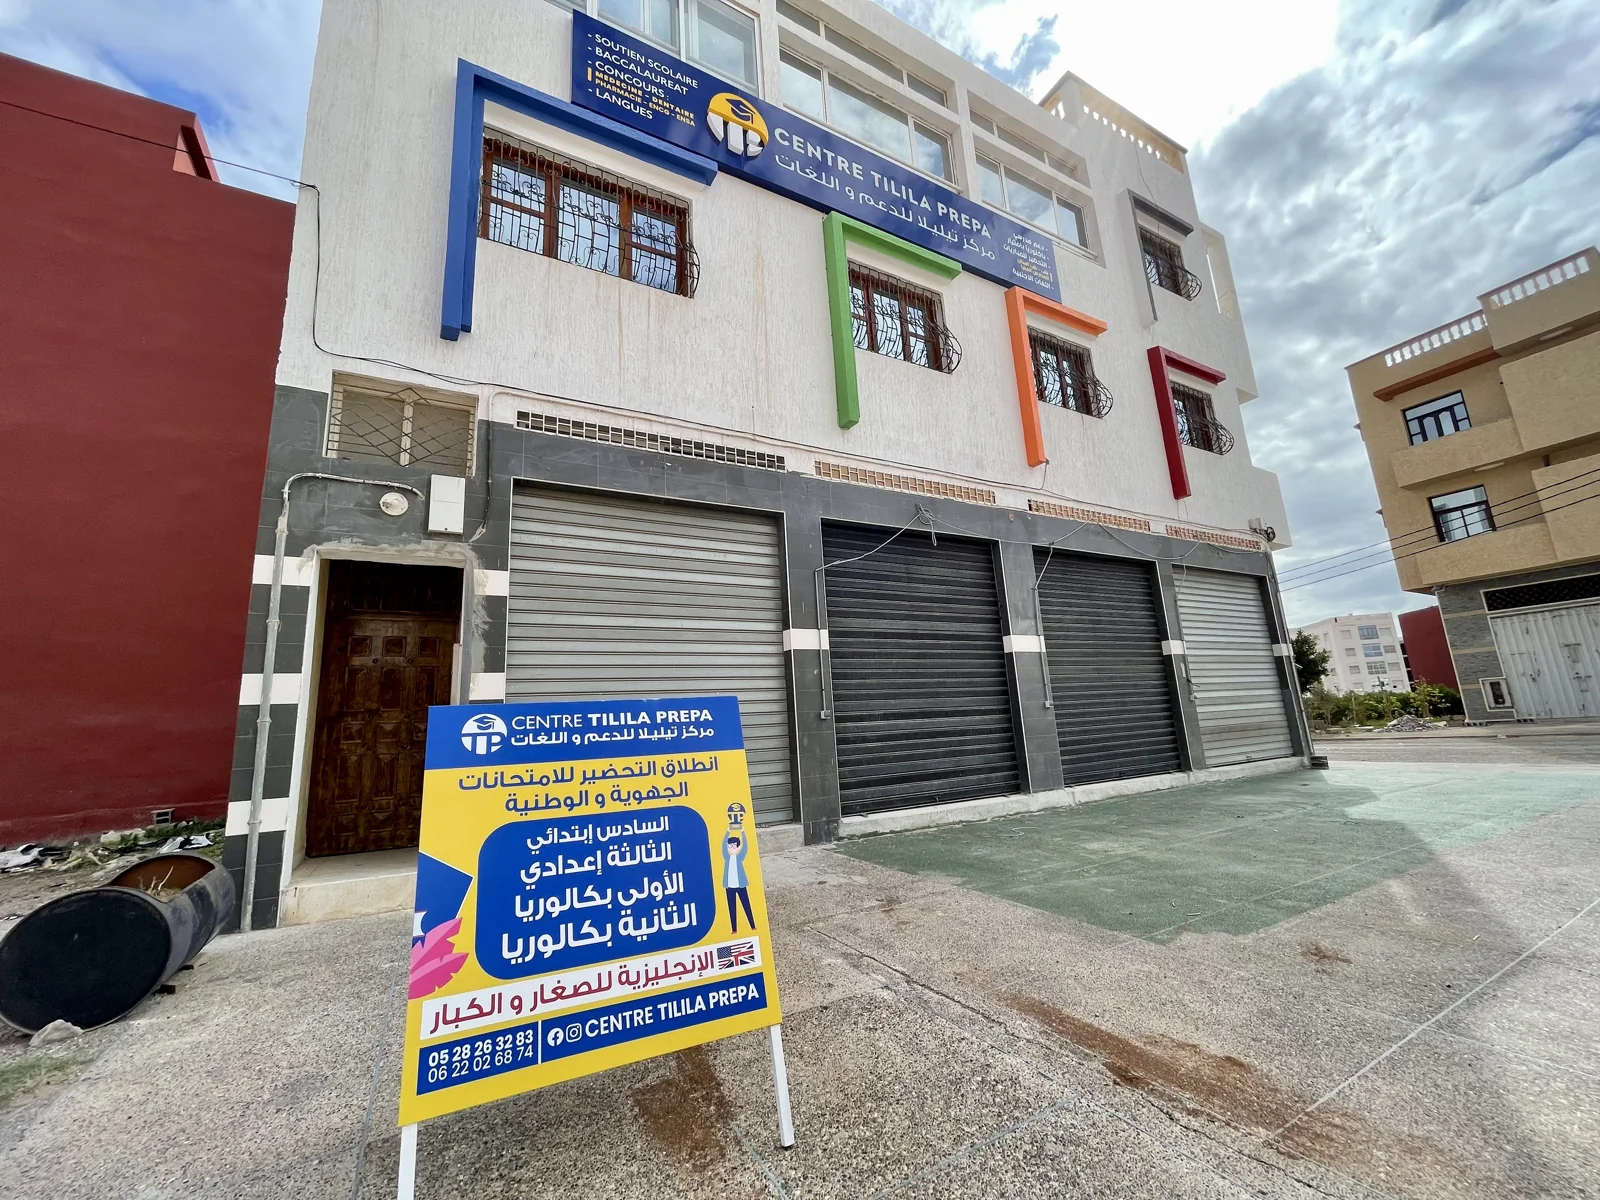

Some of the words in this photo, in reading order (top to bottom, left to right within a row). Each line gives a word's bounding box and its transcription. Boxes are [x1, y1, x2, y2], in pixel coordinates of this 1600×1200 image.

[595, 34, 645, 64] SOUTIEN
[647, 59, 699, 89] SCOLAIRE
[595, 47, 689, 95] BACCALAUREAT
[595, 61, 665, 98] CONCOURS
[595, 71, 643, 97] MEDECINE
[652, 96, 695, 119] DENTAIRE
[595, 78, 642, 104] PHARMACIE
[676, 114, 696, 127] ENSA
[596, 88, 653, 119] LANGUES
[774, 127, 864, 180] CENTRE
[870, 170, 931, 212] TILILA
[937, 202, 991, 239] PREPA
[775, 154, 840, 191] اللغات
[845, 186, 855, 200] و
[859, 192, 913, 222] للدعم
[917, 214, 958, 243] تيليلا
[962, 235, 996, 260] مركز
[511, 714, 583, 730] CENTRE
[587, 711, 651, 726] TILILA
[656, 709, 713, 724] PREPA
[638, 725, 678, 742] تيليلا
[681, 725, 715, 738] مركز
[510, 731, 568, 747] اللغات
[572, 734, 581, 746] و
[584, 729, 635, 745] للدعم
[458, 766, 575, 791] للامتحانات
[580, 761, 657, 787] التحضير
[661, 756, 719, 779] انطلاق
[505, 789, 589, 817] الوطنية
[595, 793, 605, 809] و
[610, 781, 689, 806] الجهوية
[526, 823, 594, 855] إبتدائي
[596, 815, 669, 842] السادس
[606, 839, 672, 867] الثالثة
[520, 849, 602, 891] إعدادي
[514, 884, 613, 923] بكالوريا
[617, 870, 685, 906] الأولى
[618, 900, 698, 942] الثانية
[501, 919, 613, 965] بكالوريا
[618, 950, 715, 992] الإنجليزية
[510, 996, 523, 1016] و
[530, 969, 613, 1013] للصغار
[429, 991, 503, 1035] الكبار
[585, 1005, 654, 1038] CENTRE
[657, 993, 706, 1021] TILILA
[708, 983, 760, 1011] PREPA
[428, 1051, 449, 1068] 05
[452, 1042, 472, 1061] 28
[474, 1039, 493, 1057] 26
[496, 1034, 513, 1052] 32
[515, 1029, 534, 1046] 83
[428, 1066, 448, 1083] 06
[451, 1060, 470, 1078] 22
[472, 1054, 491, 1072] 02
[494, 1048, 513, 1066] 68
[516, 1044, 534, 1061] 74
